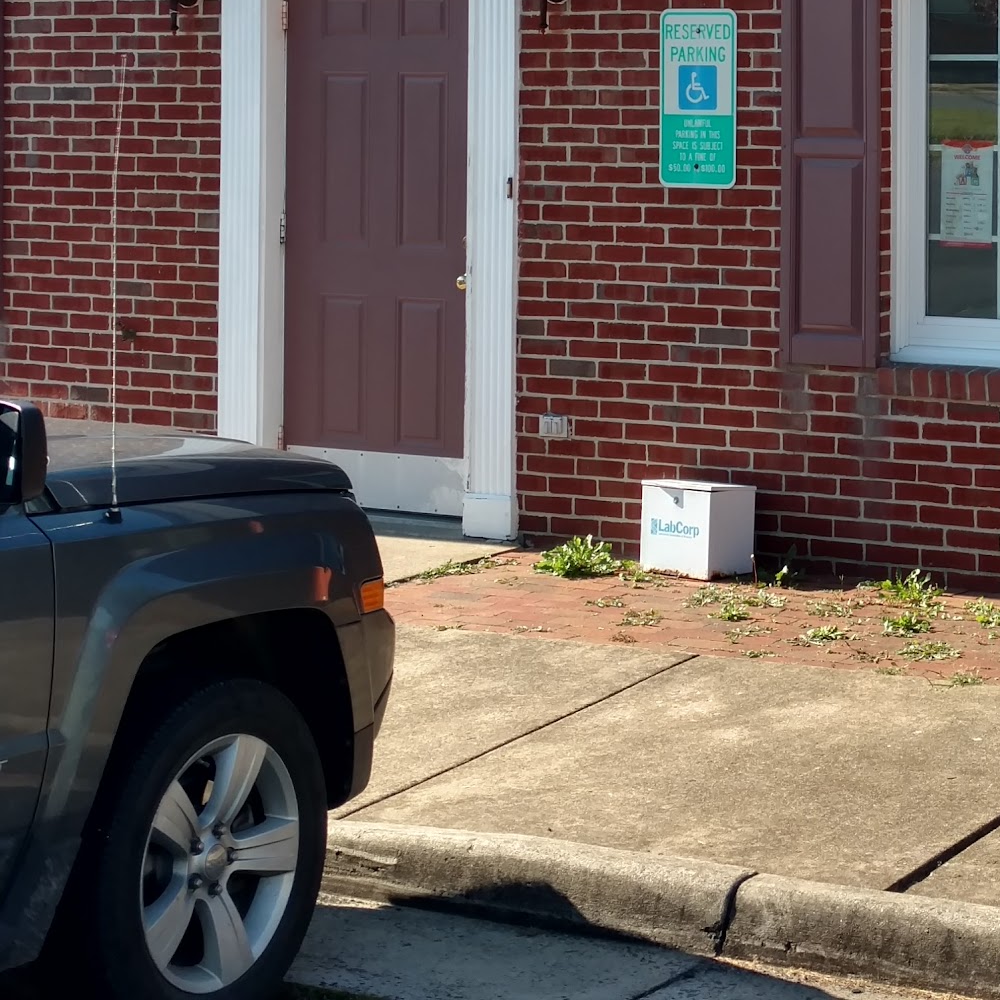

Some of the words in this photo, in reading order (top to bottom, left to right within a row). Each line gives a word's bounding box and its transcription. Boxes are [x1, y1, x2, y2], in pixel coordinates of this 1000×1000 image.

[665, 23, 731, 40] RESERVED
[670, 46, 726, 62] PARKING
[683, 118, 712, 128] UNLAWFUL
[675, 130, 698, 139] PARKING
[700, 131, 707, 139] IN
[708, 131, 721, 140] THIS
[672, 141, 689, 150] SPACE
[691, 142, 698, 150] IS
[699, 142, 723, 151] SUBJECT
[679, 152, 687, 161] TO
[688, 153, 693, 161] A
[694, 153, 707, 162] FINE
[709, 153, 717, 162] OF
[668, 163, 691, 172] $50.00
[700, 164, 726, 173] $100.00
[658, 519, 700, 538] LabCorp
